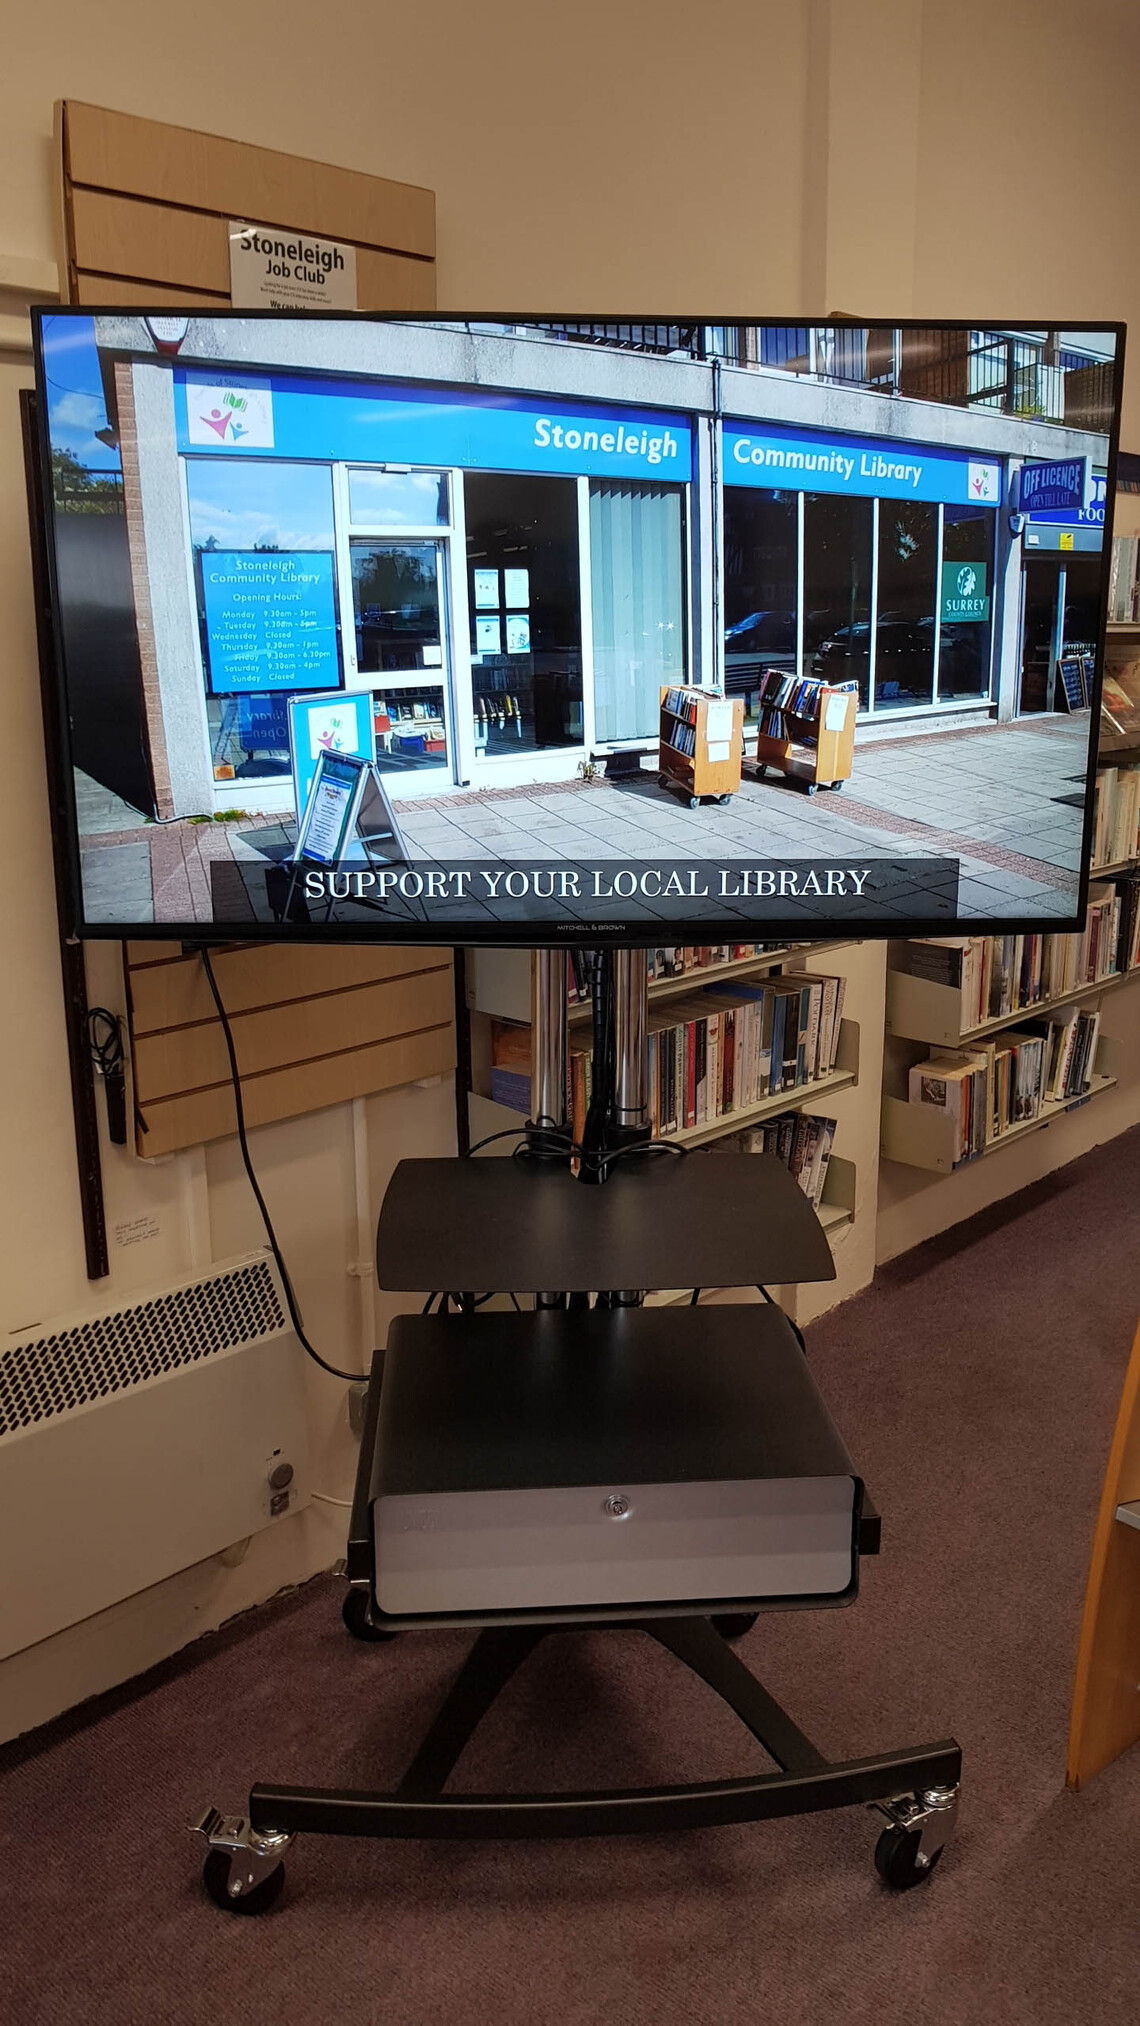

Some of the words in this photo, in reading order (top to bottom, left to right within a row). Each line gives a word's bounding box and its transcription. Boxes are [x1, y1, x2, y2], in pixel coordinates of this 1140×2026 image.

[241, 229, 344, 272] Stoneleigh
[266, 260, 291, 278] Job
[294, 266, 325, 285] Club
[534, 418, 677, 464] Stoneleigh
[733, 438, 854, 481] Community
[859, 453, 922, 487] Library
[1023, 469, 1041, 500] OFF
[1041, 465, 1081, 495] LICENCE
[235, 559, 295, 573] Stoneleigh
[210, 573, 277, 585] Community
[281, 573, 320, 584] Library
[232, 593, 271, 603] Opening
[946, 599, 986, 611] SURREY
[222, 611, 255, 620] Monday
[263, 610, 292, 618] 9.30am
[300, 609, 317, 618] 5pm
[223, 621, 257, 630] Tuesday
[212, 632, 257, 641] Wednesday
[265, 631, 292, 639] Closed
[222, 643, 258, 652] Thursday
[234, 653, 259, 662] Friday
[303, 650, 331, 660] 6.30pm
[224, 664, 260, 673] Saturday
[267, 662, 296, 670] 9.30am
[304, 661, 321, 670] 4pm
[232, 674, 261, 683] Sunday
[269, 673, 295, 681] Closed
[304, 870, 471, 900] SUPPORT
[479, 870, 582, 899] YOUR
[590, 869, 708, 898] LOCAL
[717, 868, 871, 898] LIBRARY
